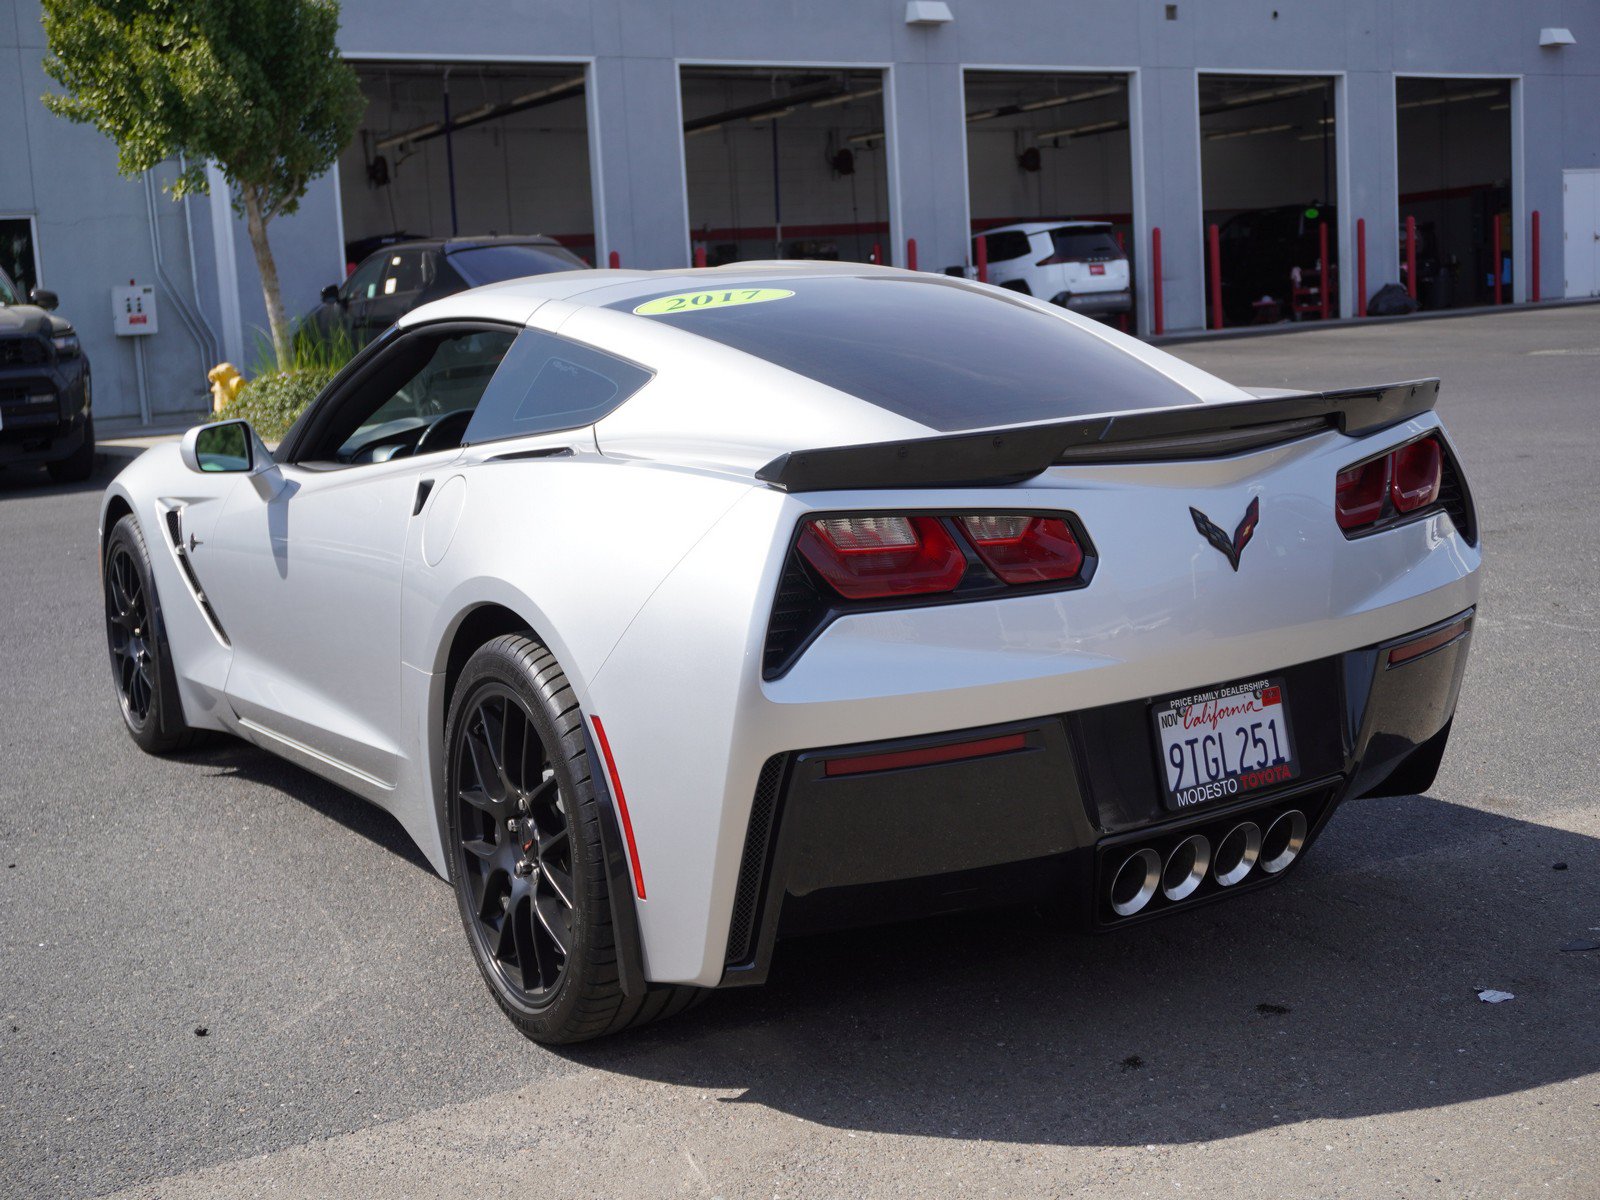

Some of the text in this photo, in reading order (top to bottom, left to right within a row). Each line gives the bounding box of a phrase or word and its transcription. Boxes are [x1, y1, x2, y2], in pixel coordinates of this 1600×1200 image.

[666, 290, 761, 311] 2017
[1170, 696, 1192, 709] PRICE
[1194, 690, 1220, 704] FAMILY
[1220, 679, 1270, 698] DEALERSHIPS
[1161, 713, 1178, 729] NOV
[1183, 700, 1263, 730] California
[1169, 719, 1286, 792] 9TGL251
[1177, 765, 1292, 807] MODESTO TOYOTA
